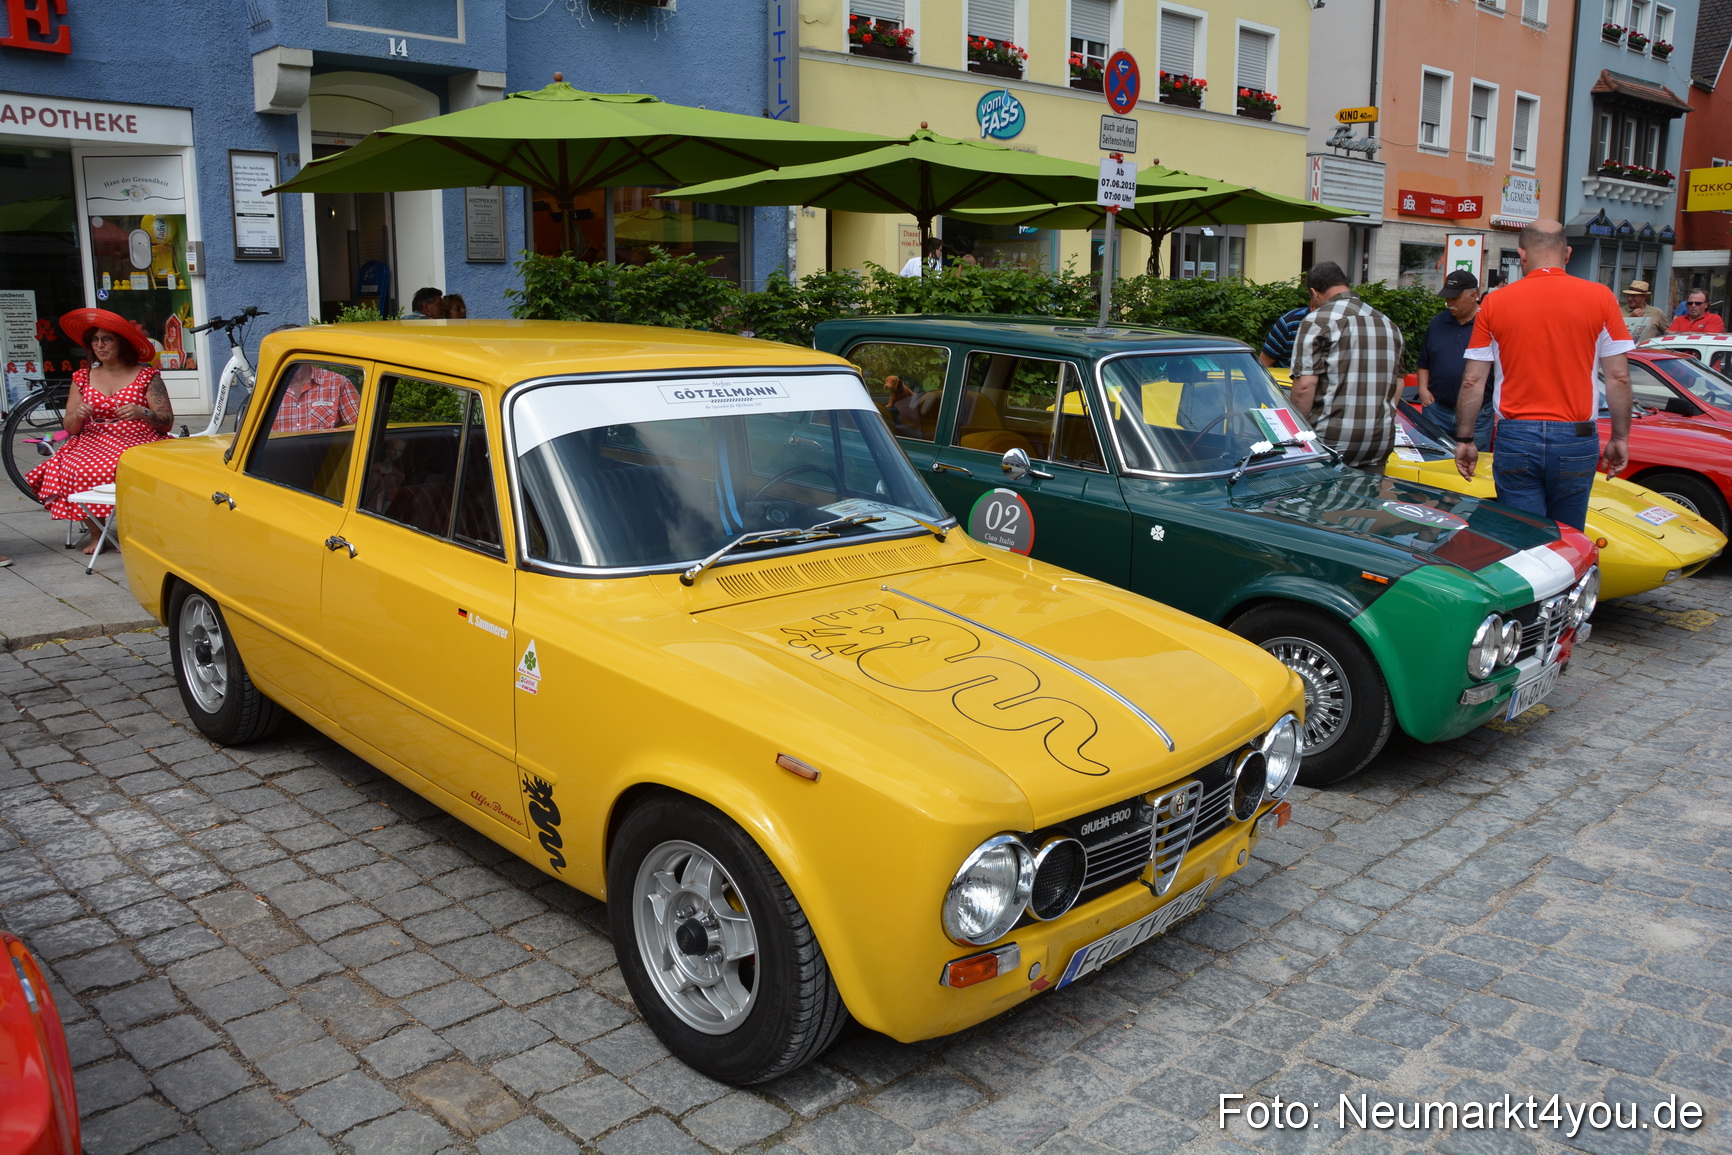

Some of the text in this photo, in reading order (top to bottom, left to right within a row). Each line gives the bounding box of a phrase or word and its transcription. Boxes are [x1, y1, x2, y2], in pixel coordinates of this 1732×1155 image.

[388, 38, 408, 57] 14
[981, 95, 1001, 115] vom
[1, 104, 138, 134] APOTHEKE
[981, 100, 1019, 138] FASS
[1339, 110, 1358, 121] KINO
[1103, 122, 1135, 135] auch auf dem
[1102, 134, 1135, 148] Seitenstreifen
[1116, 167, 1124, 176] Ab
[1311, 156, 1321, 201] KIN
[103, 179, 120, 188] Haus
[133, 176, 169, 188] Gesundheit
[1101, 178, 1136, 191] 07.06.2015
[1513, 179, 1533, 192] OBST &
[1103, 191, 1132, 202] 07:00 Uhr
[1510, 190, 1532, 204] GEMÜSE
[1457, 201, 1477, 212] DER
[673, 386, 778, 400] GÖTZELMANN
[985, 501, 1021, 535] 02
[984, 532, 1015, 546] Ciao Italia
[467, 612, 509, 640] A. Summerer
[521, 684, 537, 695] racing
[470, 790, 523, 826] Alfa Romeo
[1076, 939, 1118, 976] FÜ
[1130, 908, 1168, 946] TY
